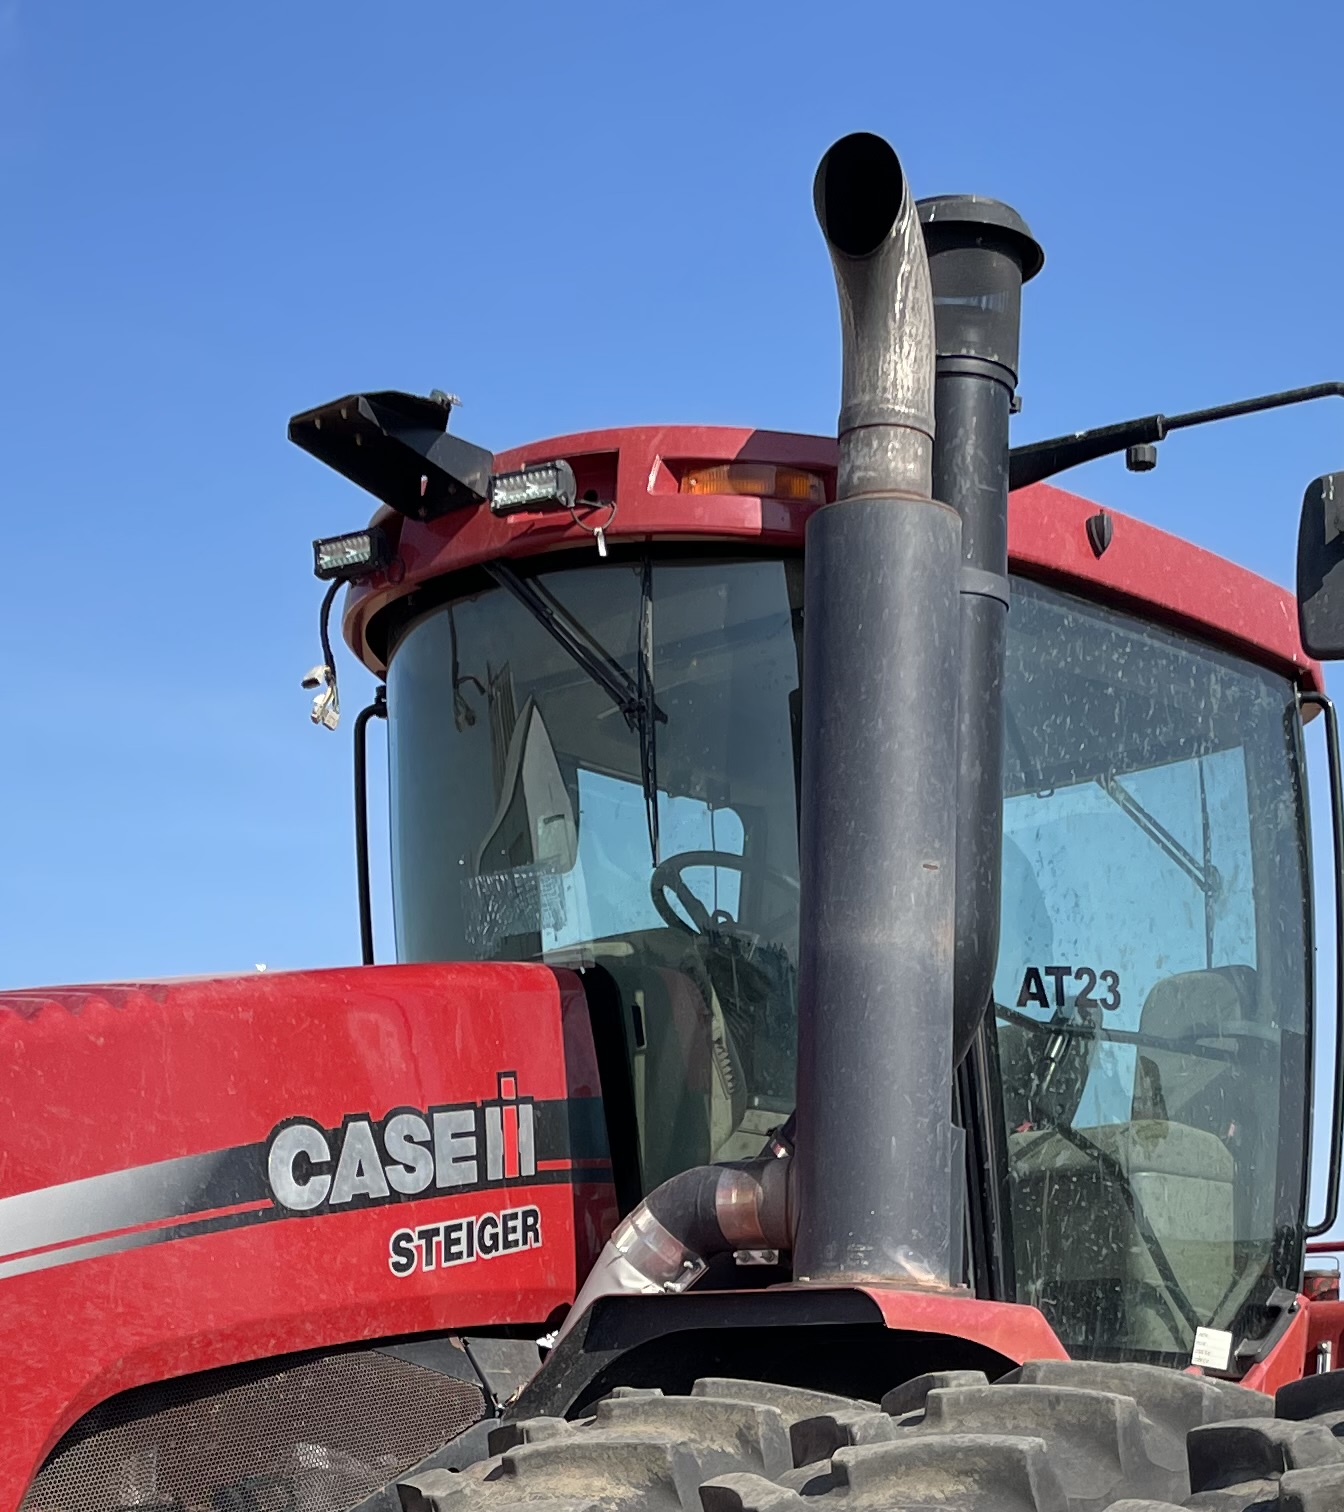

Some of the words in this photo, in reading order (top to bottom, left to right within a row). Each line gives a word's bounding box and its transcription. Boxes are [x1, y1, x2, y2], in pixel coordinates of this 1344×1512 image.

[1016, 965, 1122, 1012] AT23
[268, 1109, 478, 1211] CASE
[388, 1204, 542, 1278] STEIGER
